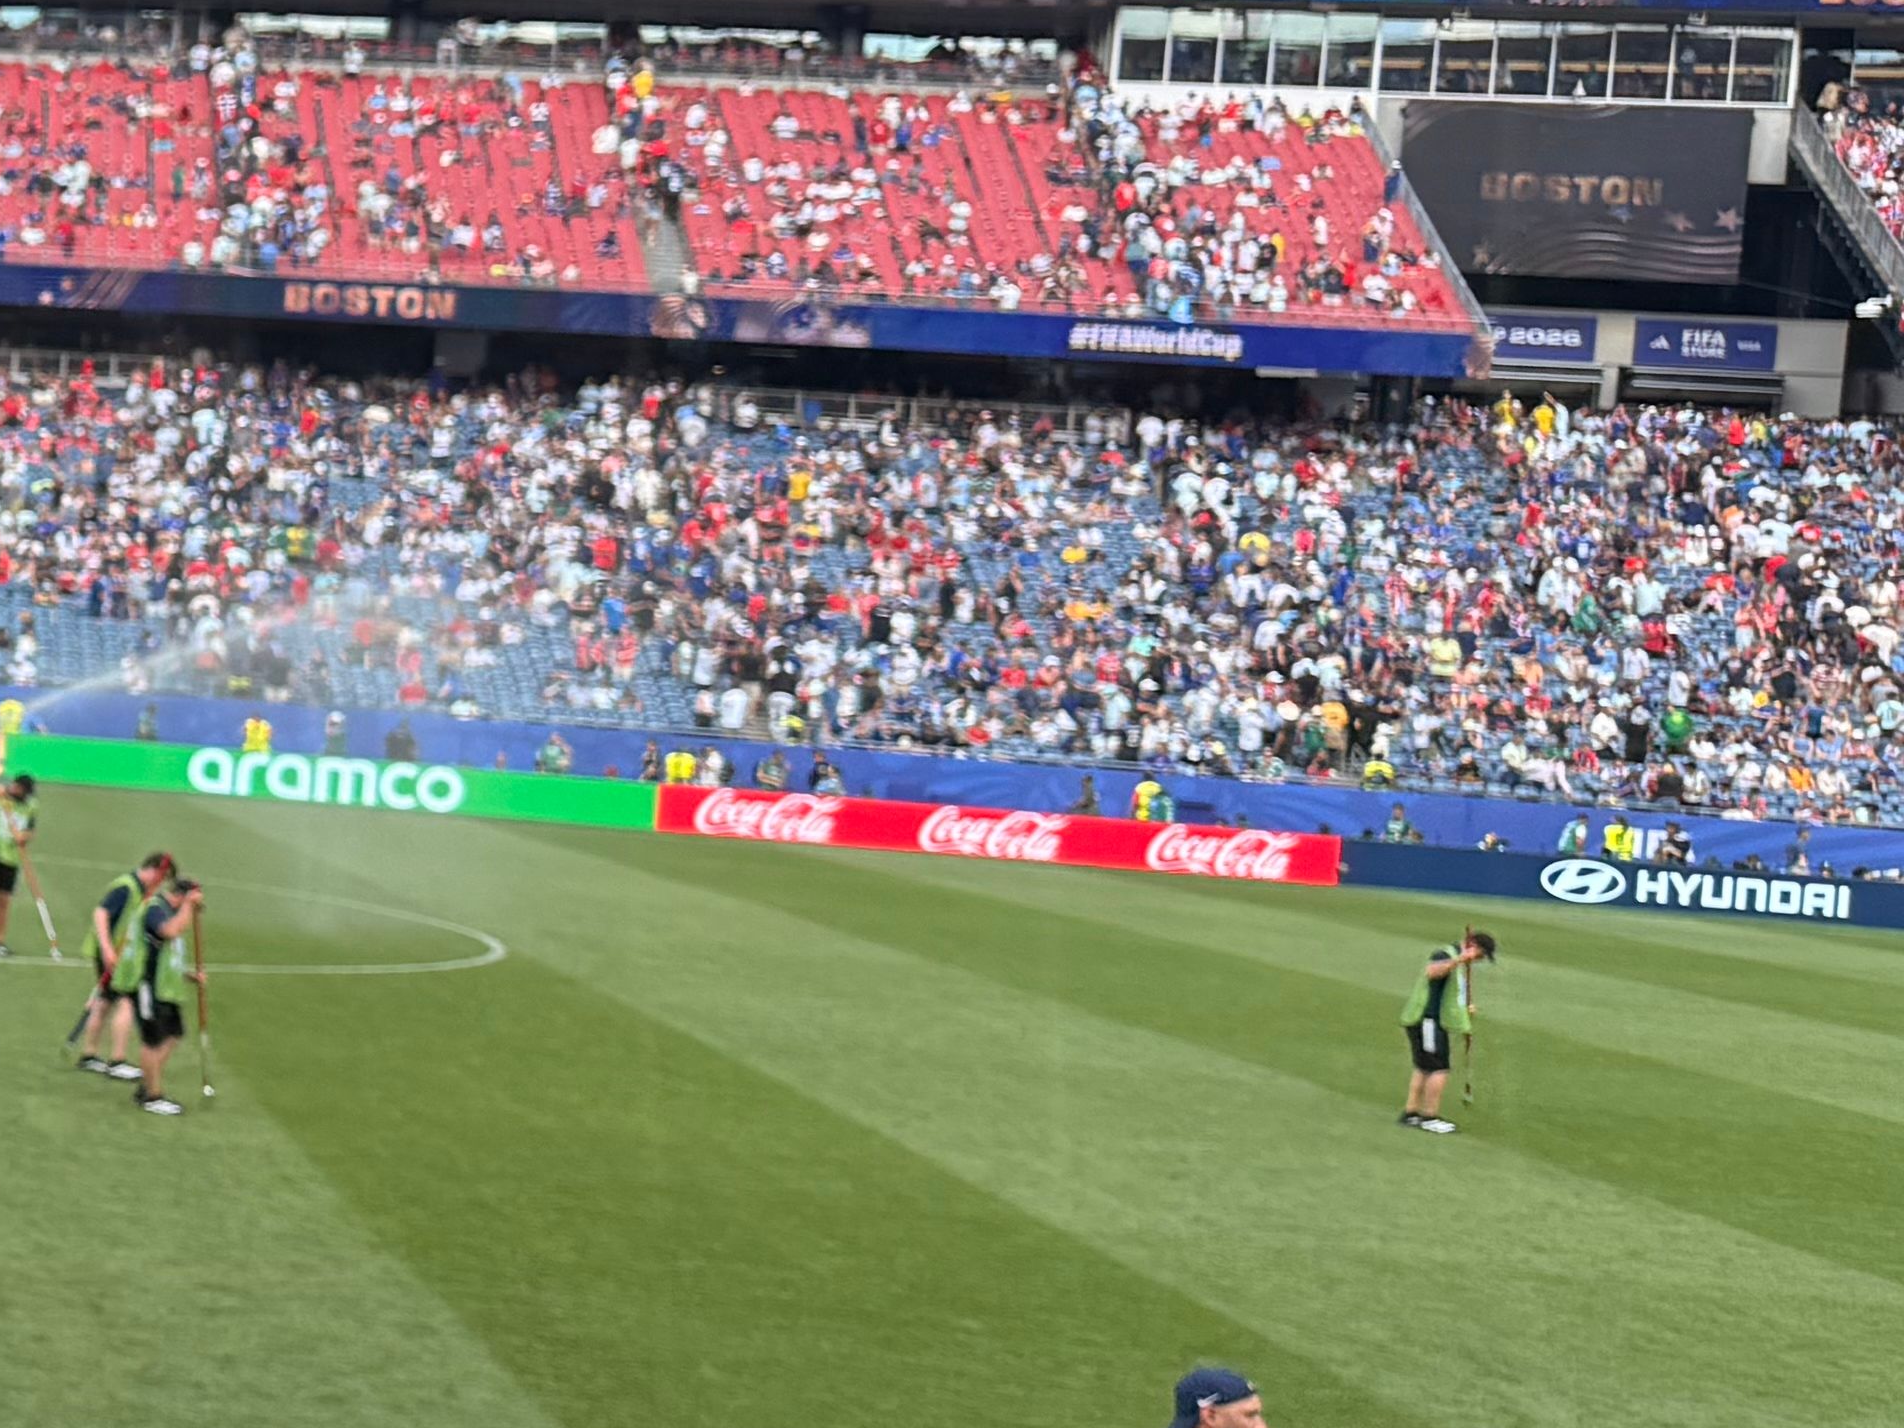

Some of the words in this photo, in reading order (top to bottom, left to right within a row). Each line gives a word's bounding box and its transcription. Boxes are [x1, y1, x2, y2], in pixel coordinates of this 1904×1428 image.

[1481, 172, 1664, 206] BOSTON
[284, 283, 456, 320] BOSTON
[1508, 327, 1583, 347] 2026
[1681, 329, 1726, 348] FIFA
[187, 746, 465, 814] aramco
[1635, 869, 1851, 919] HYUNDAI
